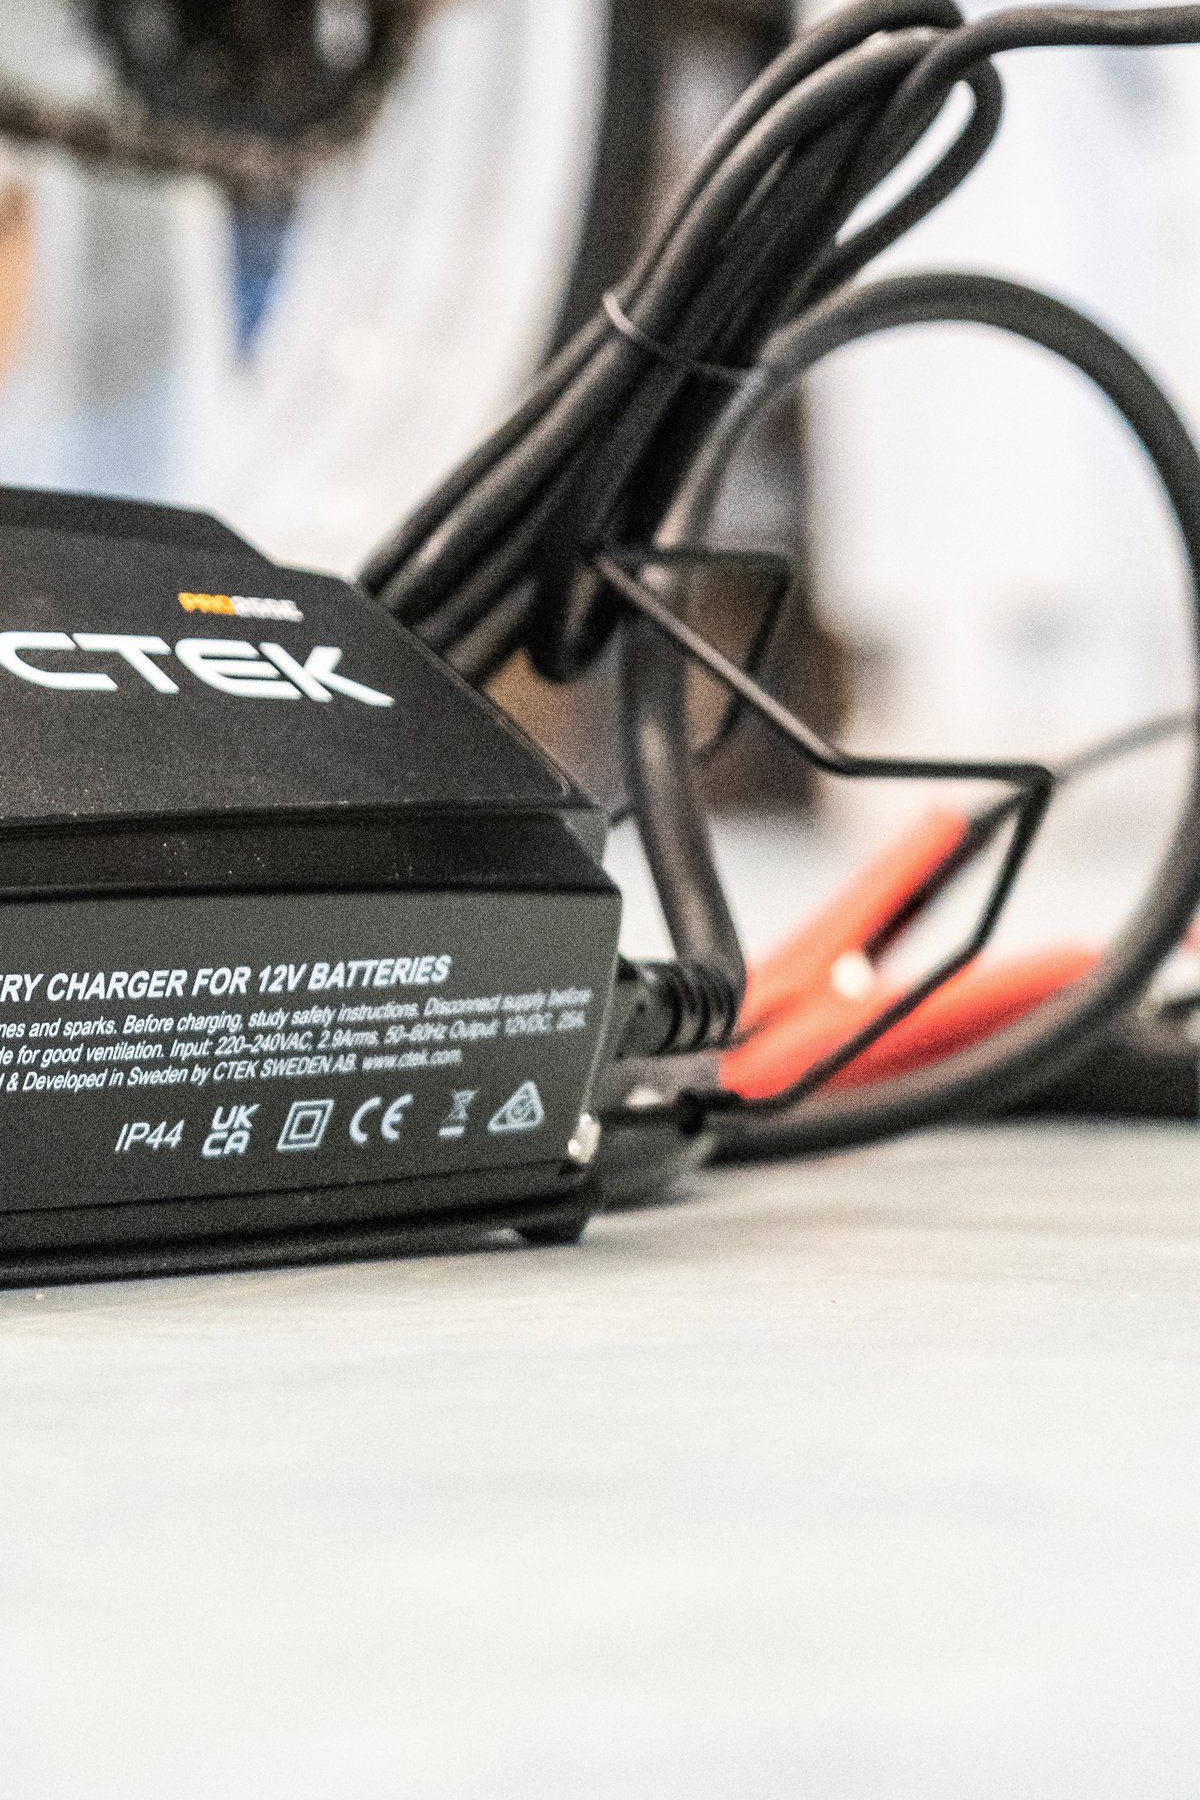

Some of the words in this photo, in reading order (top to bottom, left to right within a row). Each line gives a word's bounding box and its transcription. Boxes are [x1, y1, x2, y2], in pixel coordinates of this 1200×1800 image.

[46, 970, 188, 1002] CHARGER
[192, 967, 251, 997] FOR
[258, 963, 305, 993] 12V
[308, 955, 452, 990] BATTERIES
[29, 1018, 61, 1037] and
[63, 1016, 117, 1040] sparks.
[123, 1014, 173, 1034] Before
[177, 1011, 243, 1034] charging,
[248, 1007, 289, 1030] study
[291, 1003, 337, 1027] safety
[16, 1045, 39, 1064] for
[41, 1043, 83, 1068] good
[86, 1041, 164, 1062] ventilation.
[170, 1039, 213, 1060] Input:
[6, 1072, 19, 1091] &
[22, 1069, 108, 1092] Developed
[109, 1068, 124, 1086] in
[127, 1066, 188, 1086] Sweden
[190, 1064, 210, 1085] by
[213, 1060, 259, 1081] CTEK
[260, 1056, 333, 1078] SWEDEN
[211, 1104, 259, 1131] UK
[349, 1093, 415, 1144] CE
[115, 1119, 185, 1153] IP44
[201, 1130, 249, 1157] CA
